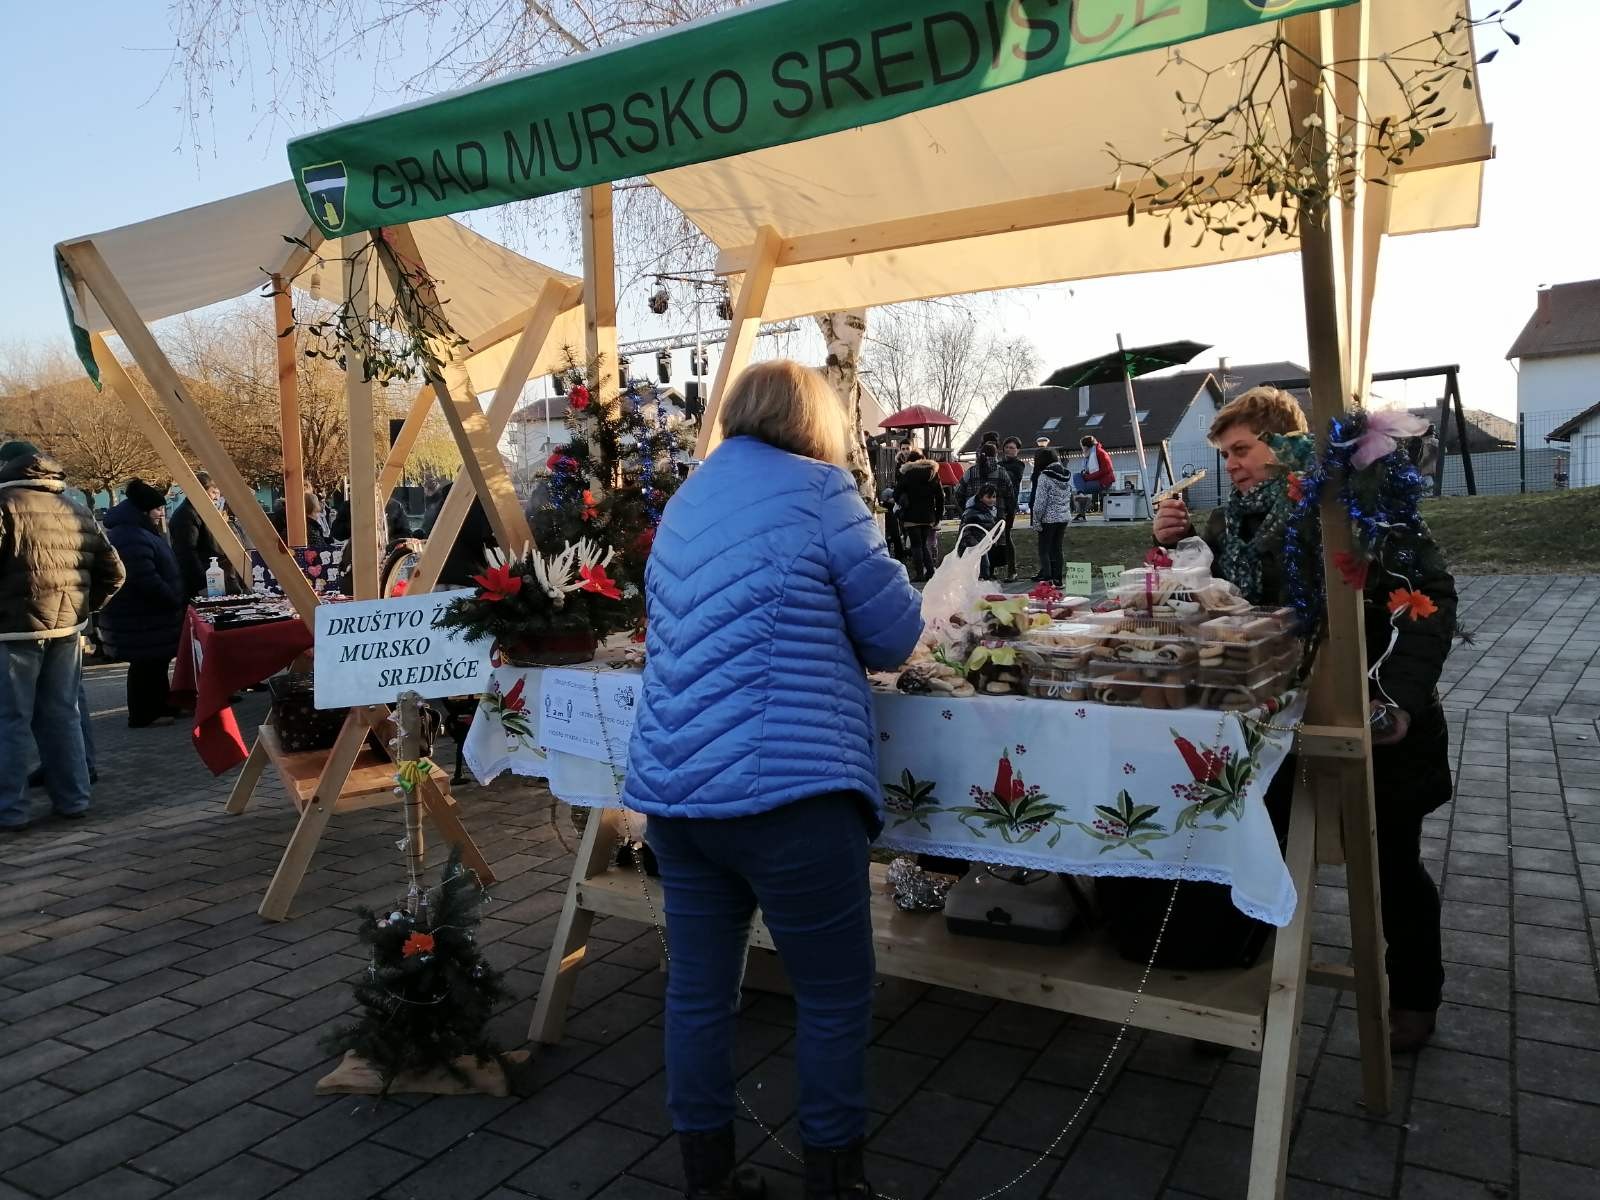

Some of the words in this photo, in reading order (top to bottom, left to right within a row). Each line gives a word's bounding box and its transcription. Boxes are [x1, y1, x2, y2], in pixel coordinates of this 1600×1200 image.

[371, 140, 489, 211] GRAD
[503, 68, 749, 184] MURSKO
[327, 609, 424, 636] DRUŠTVO
[339, 636, 431, 663] MURSKO
[378, 656, 479, 688] SREDIŠĆE
